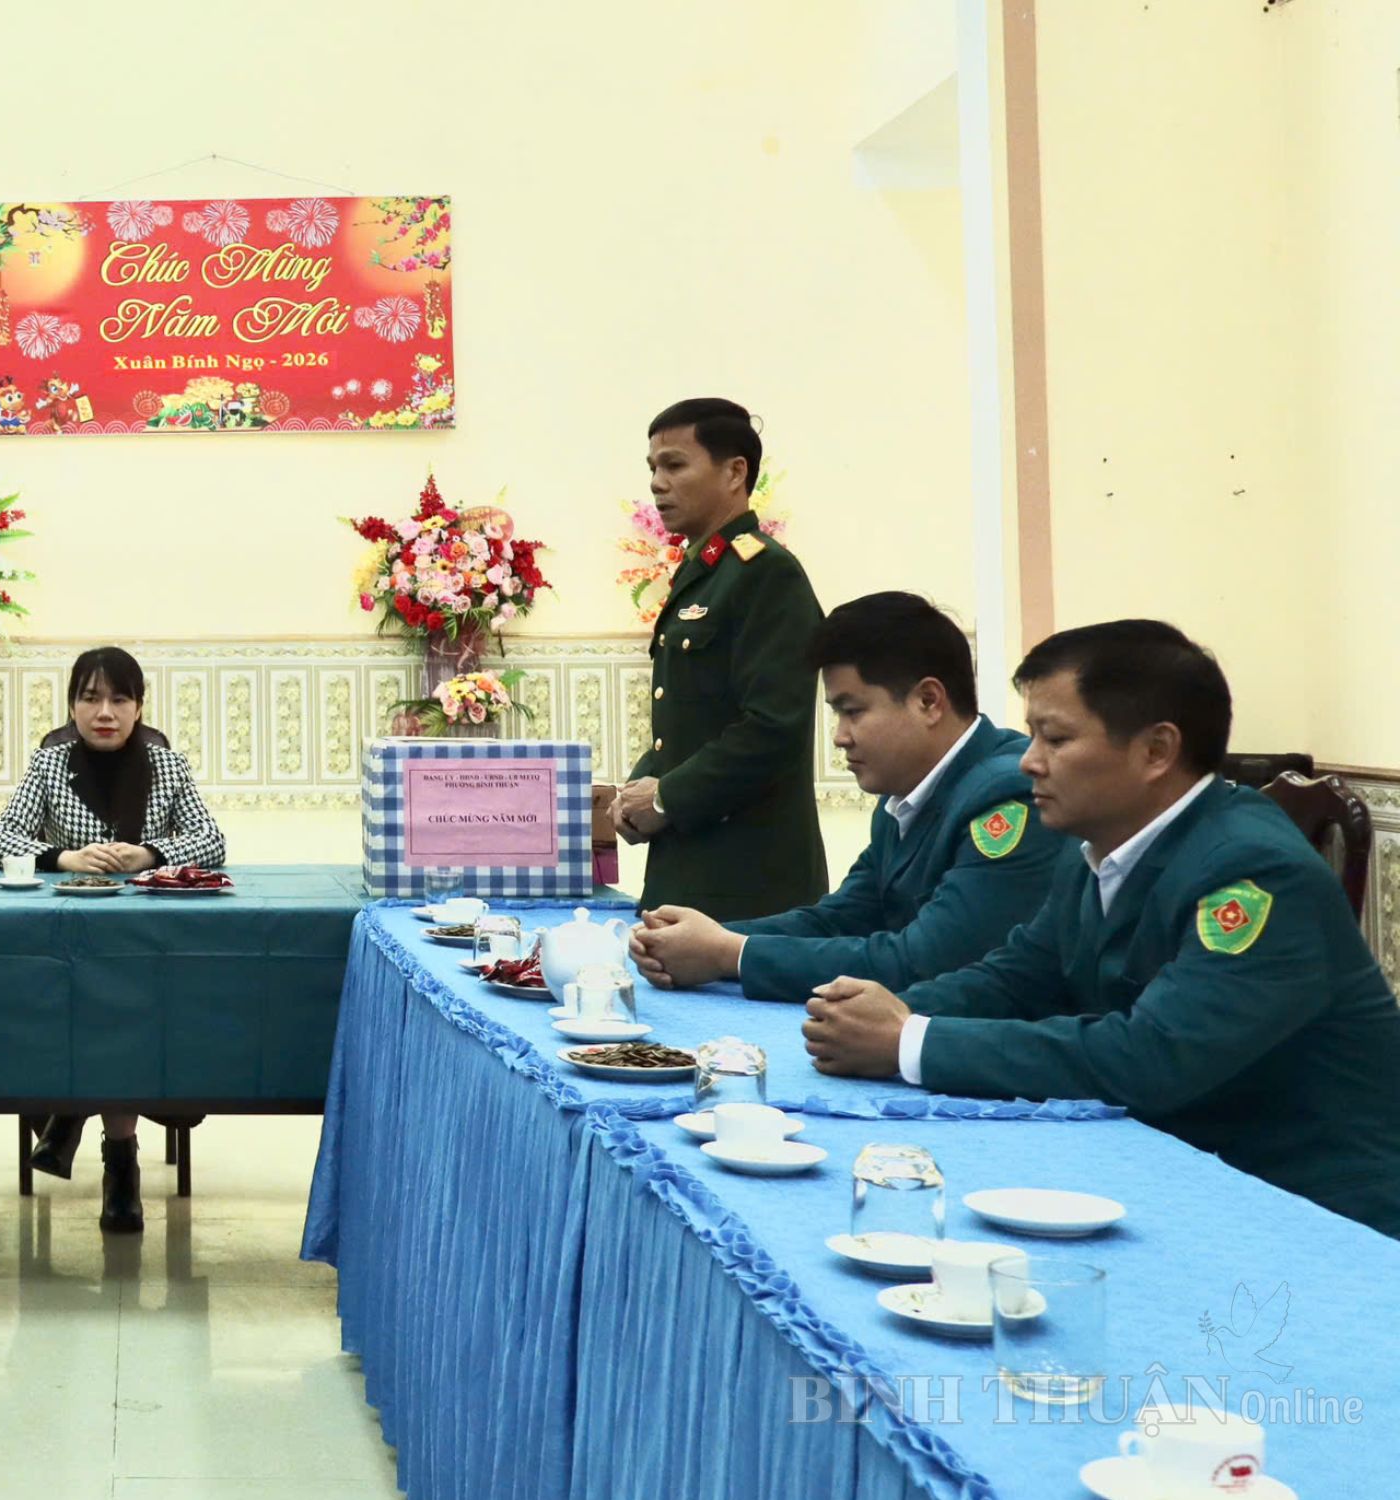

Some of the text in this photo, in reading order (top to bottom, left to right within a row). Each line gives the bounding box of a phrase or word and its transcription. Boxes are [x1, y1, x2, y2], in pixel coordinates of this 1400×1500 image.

[101, 241, 332, 292] Chúc Mừng
[100, 295, 351, 343] Năm Mới
[114, 355, 167, 370] Xuân
[172, 354, 219, 369] Bính
[225, 353, 265, 371] Ngọ
[282, 352, 329, 367] 2026
